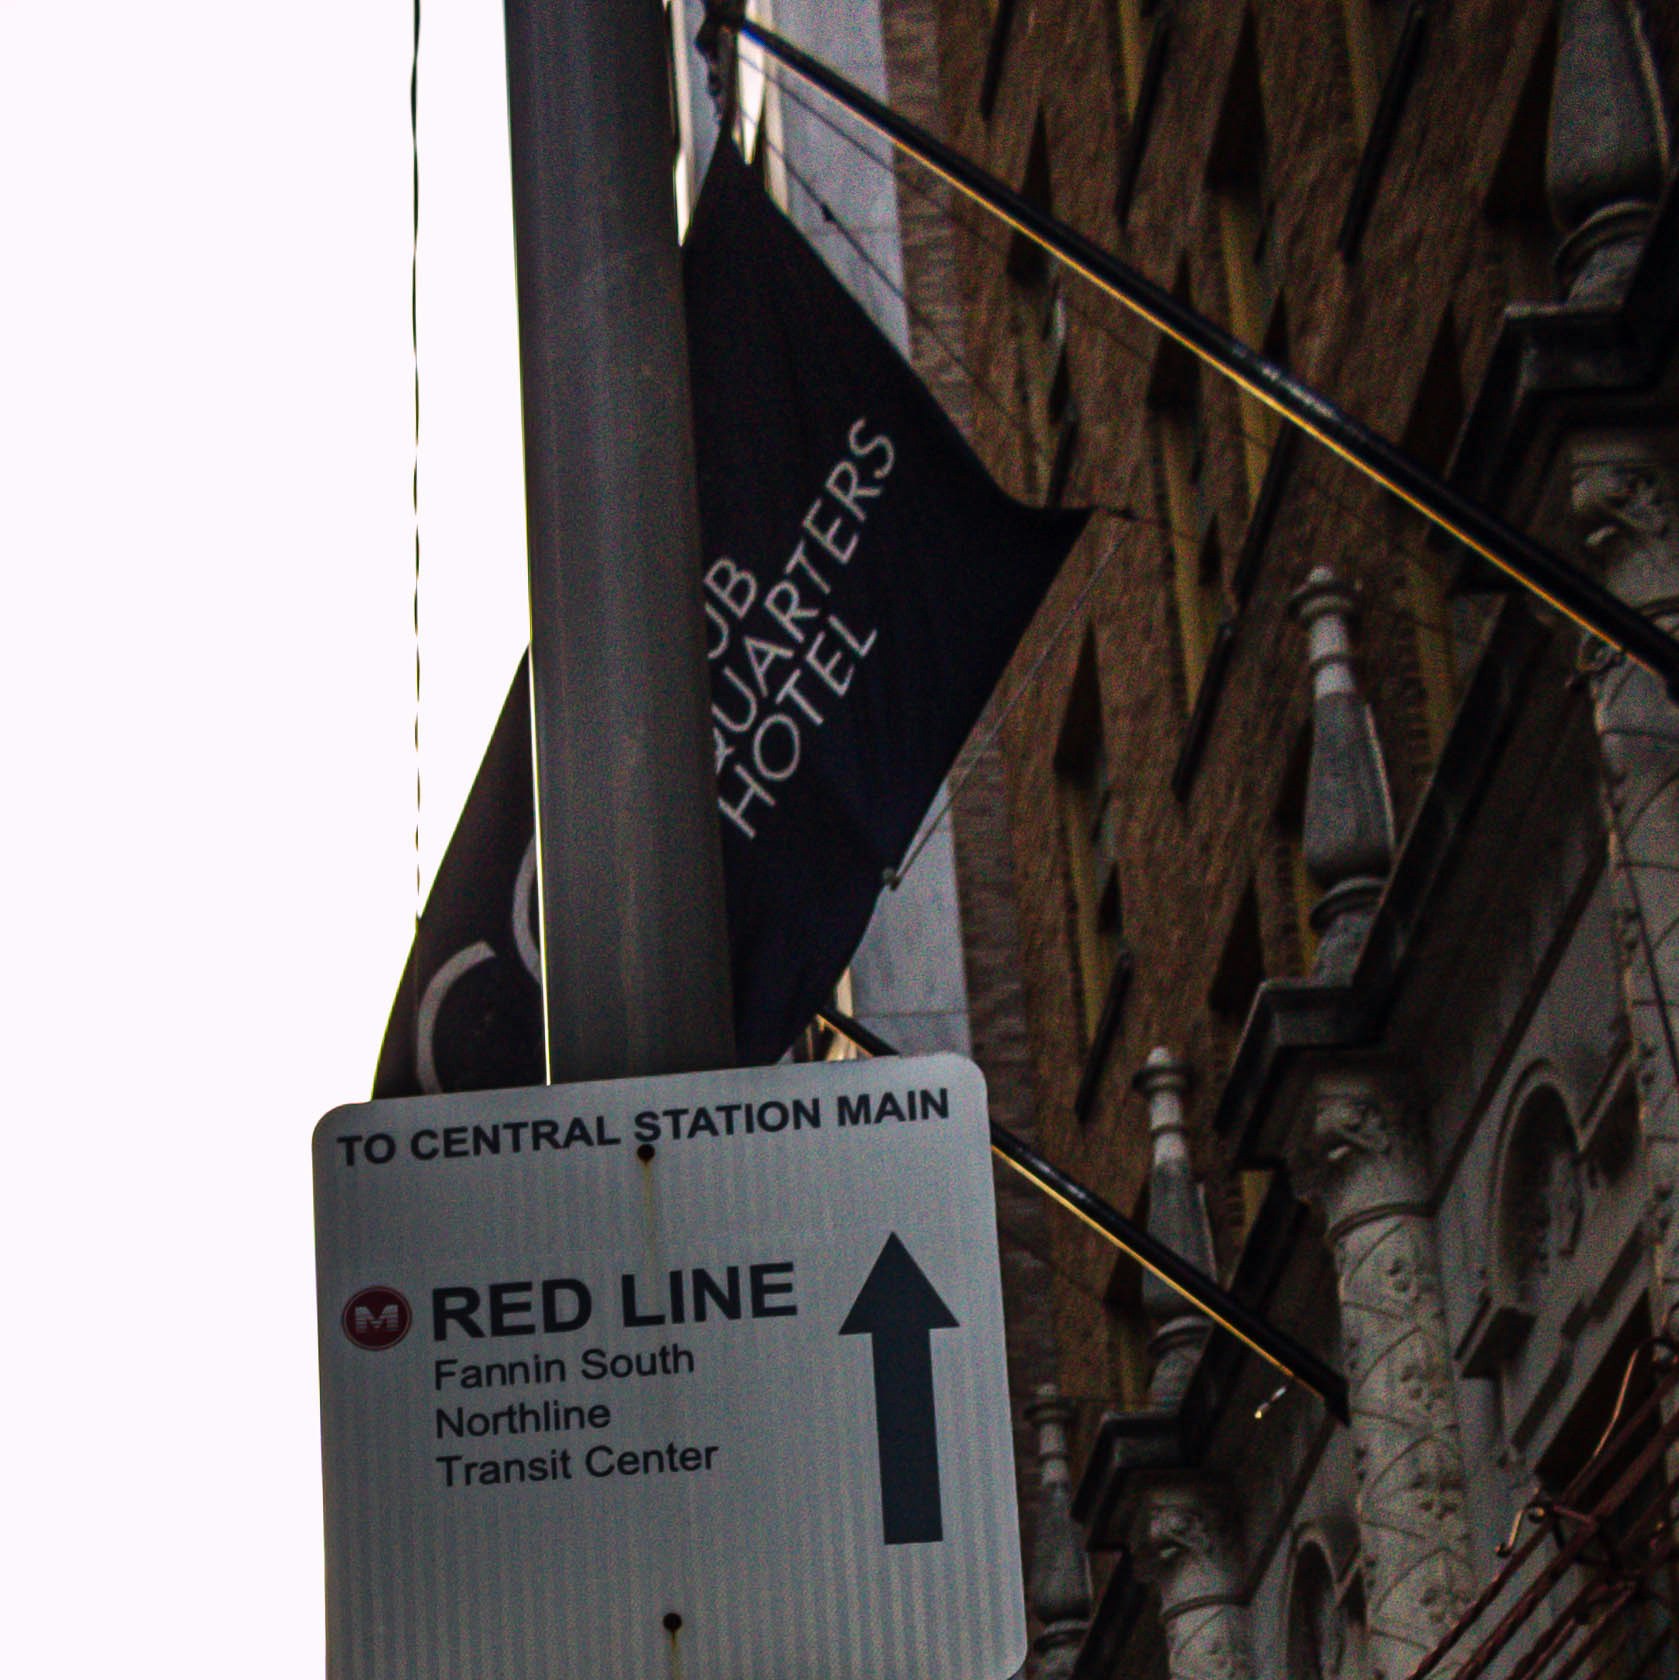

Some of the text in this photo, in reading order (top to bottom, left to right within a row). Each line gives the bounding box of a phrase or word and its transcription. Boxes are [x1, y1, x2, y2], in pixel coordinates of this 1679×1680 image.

[716, 612, 879, 840] HOTEL
[336, 1087, 950, 1167] TO CENTRAL STATION MAIN
[431, 1261, 798, 1342] RED LINE
[433, 1343, 695, 1391] Fannin South
[436, 1400, 612, 1439] Northline
[436, 1441, 719, 1487] Transit Center
